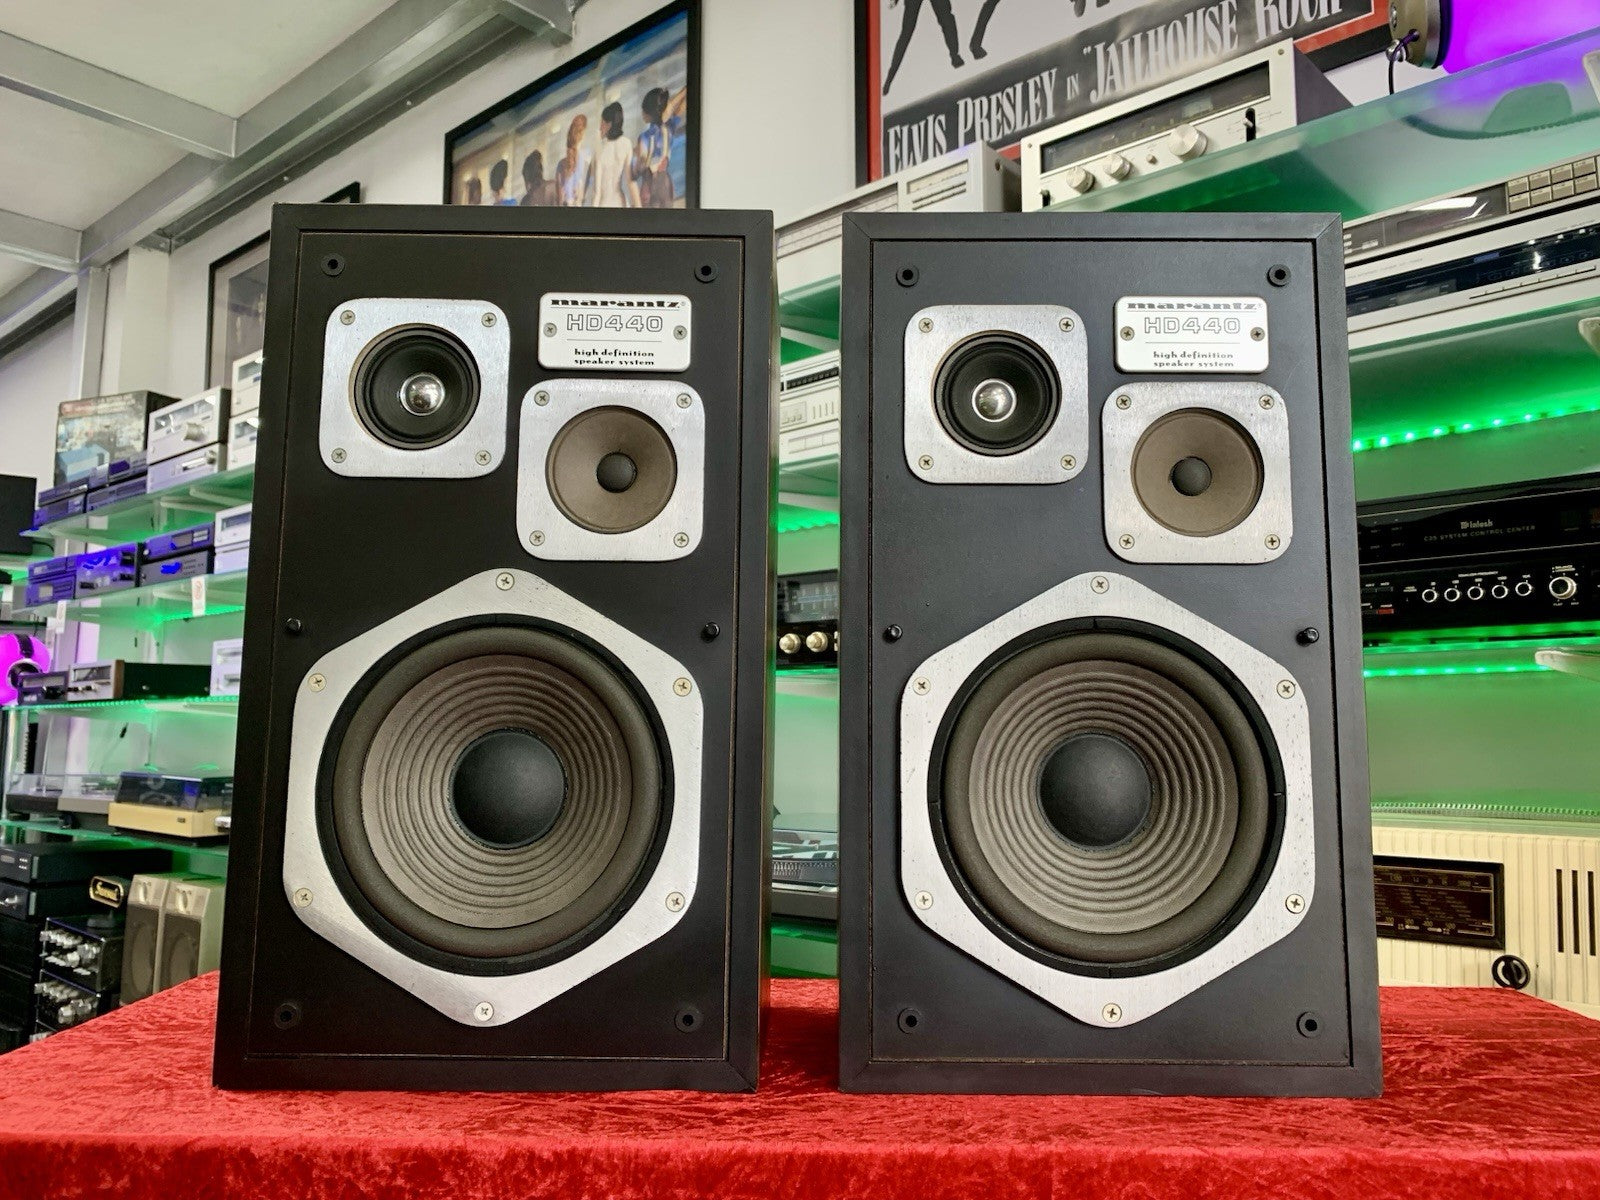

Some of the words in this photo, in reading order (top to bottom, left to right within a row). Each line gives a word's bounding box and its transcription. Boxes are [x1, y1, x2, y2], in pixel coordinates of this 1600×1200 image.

[887, 114, 947, 175] ELVIS
[957, 68, 1058, 149] PRESLEY
[1066, 73, 1080, 101] IN
[551, 299, 679, 309] marantz
[1127, 302, 1257, 311] marantz
[566, 313, 664, 333] HD440
[1144, 316, 1241, 335] HD440
[574, 348, 599, 359] high
[601, 349, 655, 358] definition
[1153, 350, 1178, 360] high
[1180, 351, 1234, 360] definition
[574, 357, 615, 367] speaker
[619, 359, 655, 367] system
[1153, 359, 1195, 369] speaker
[1198, 361, 1235, 369] system
